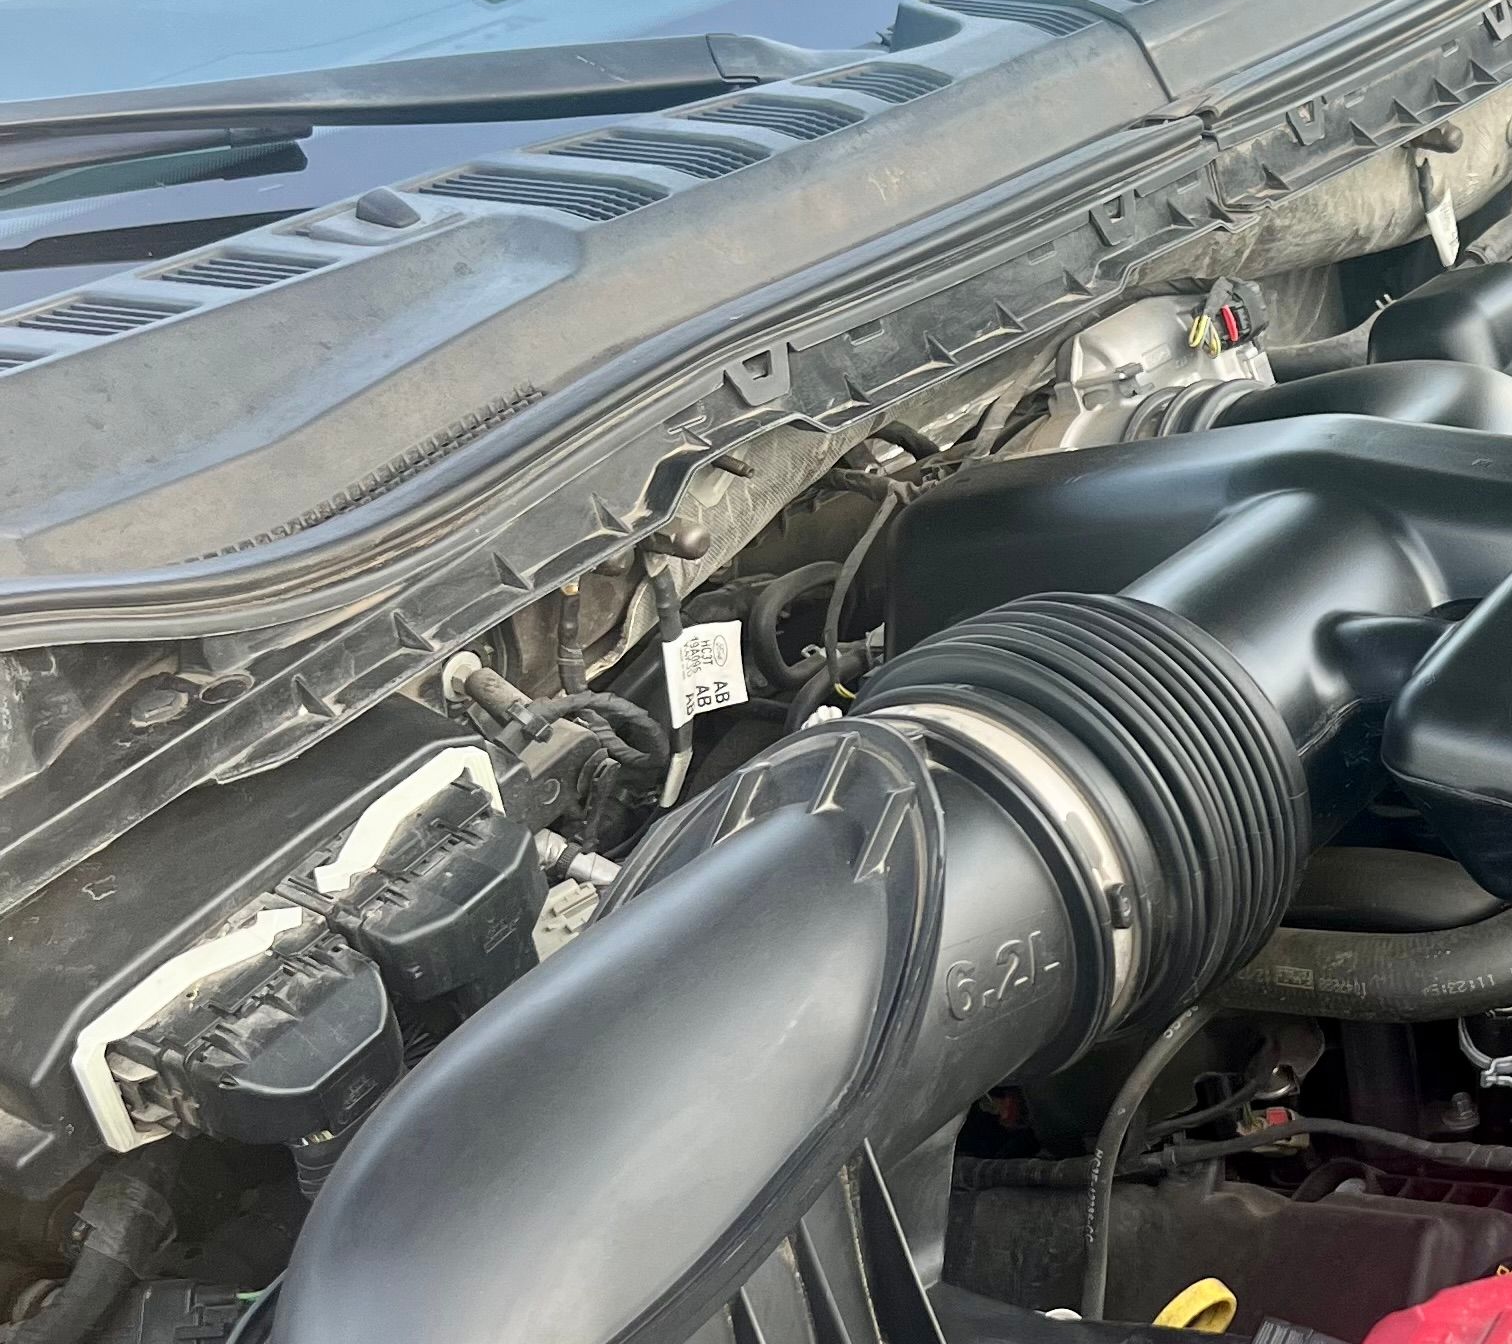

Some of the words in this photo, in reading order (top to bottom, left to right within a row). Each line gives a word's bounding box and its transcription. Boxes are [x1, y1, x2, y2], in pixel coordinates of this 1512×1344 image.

[701, 639, 712, 665] HC3T
[695, 685, 711, 707] AB
[713, 681, 729, 703] AB
